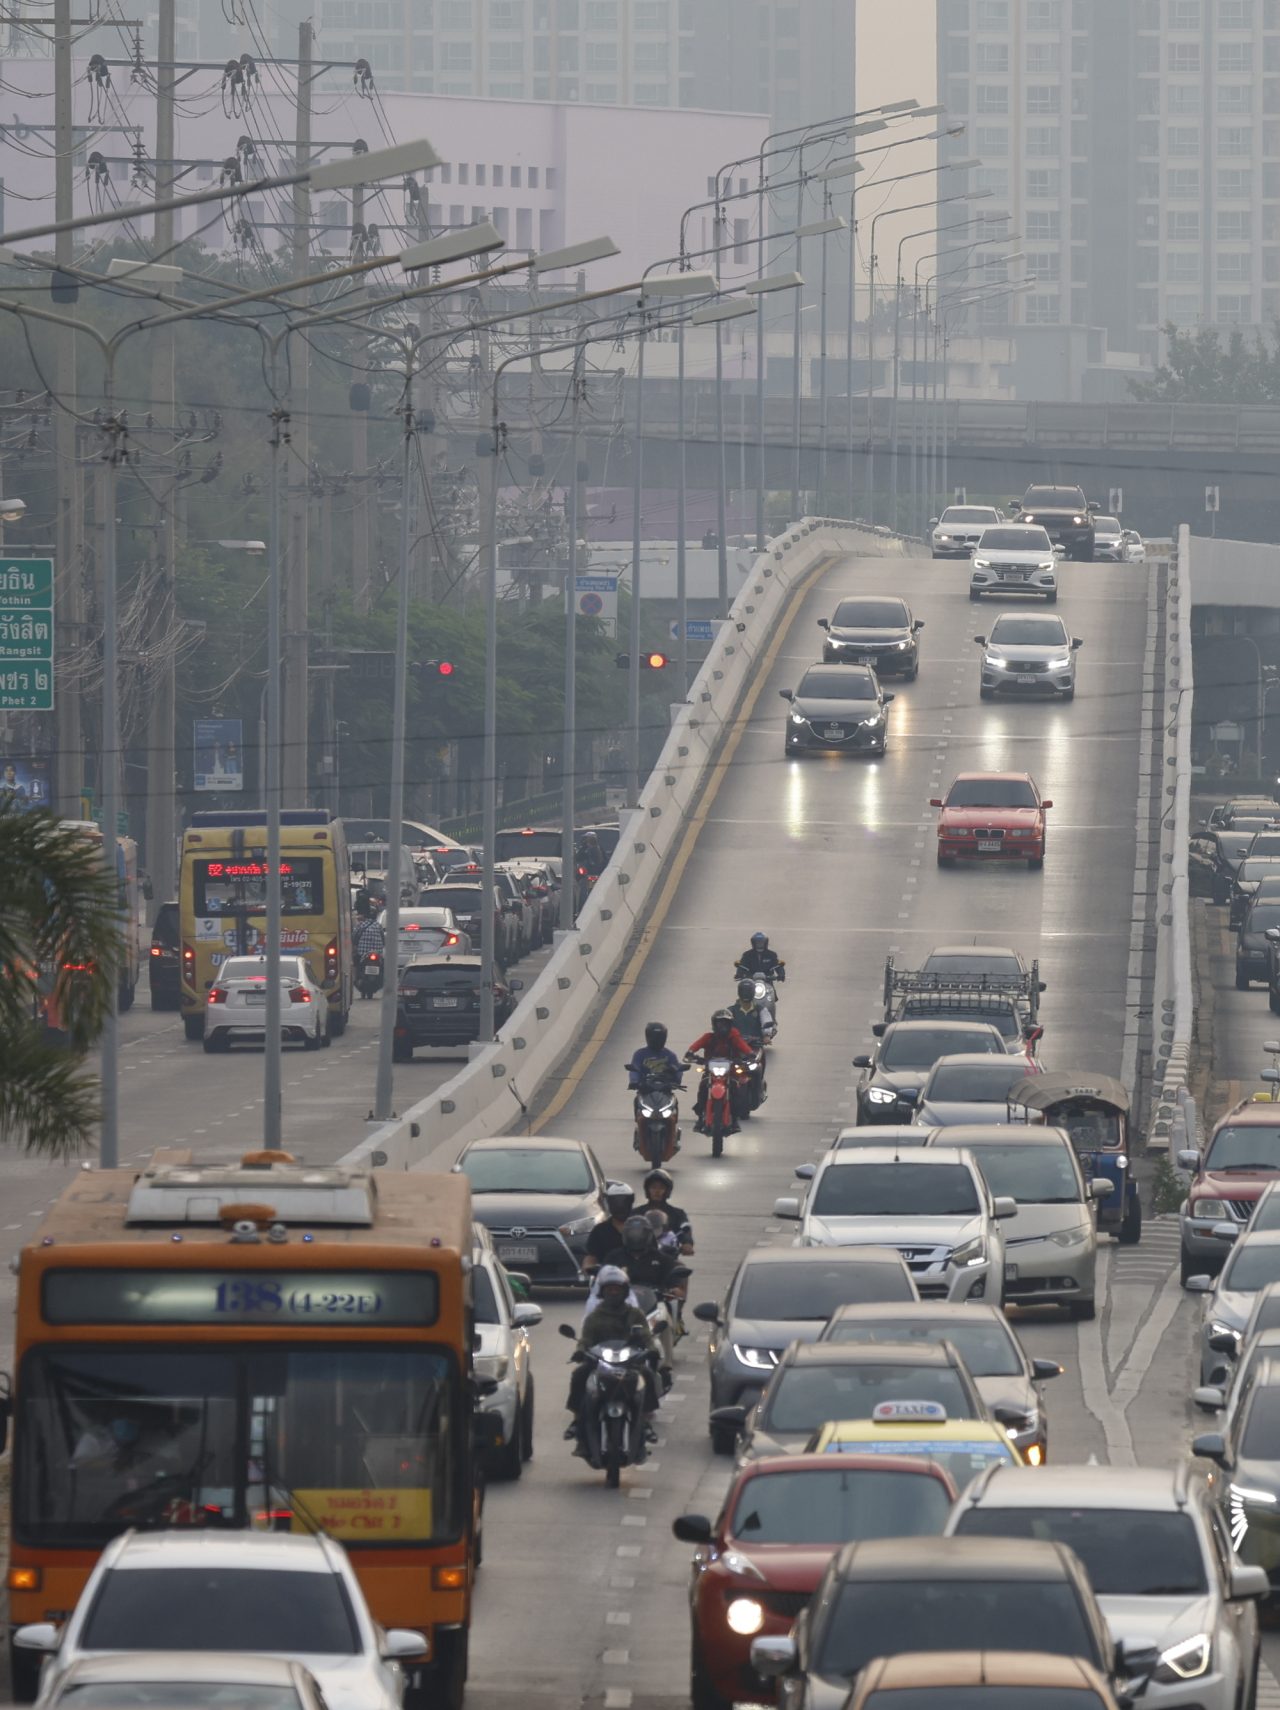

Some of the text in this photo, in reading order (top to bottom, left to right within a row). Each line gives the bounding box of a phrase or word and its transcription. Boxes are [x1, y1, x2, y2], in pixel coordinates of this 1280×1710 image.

[0, 596, 31, 605] othin
[2, 696, 36, 705] Phet 2
[215, 1281, 283, 1313] 138
[895, 1404, 924, 1415] TAXI
